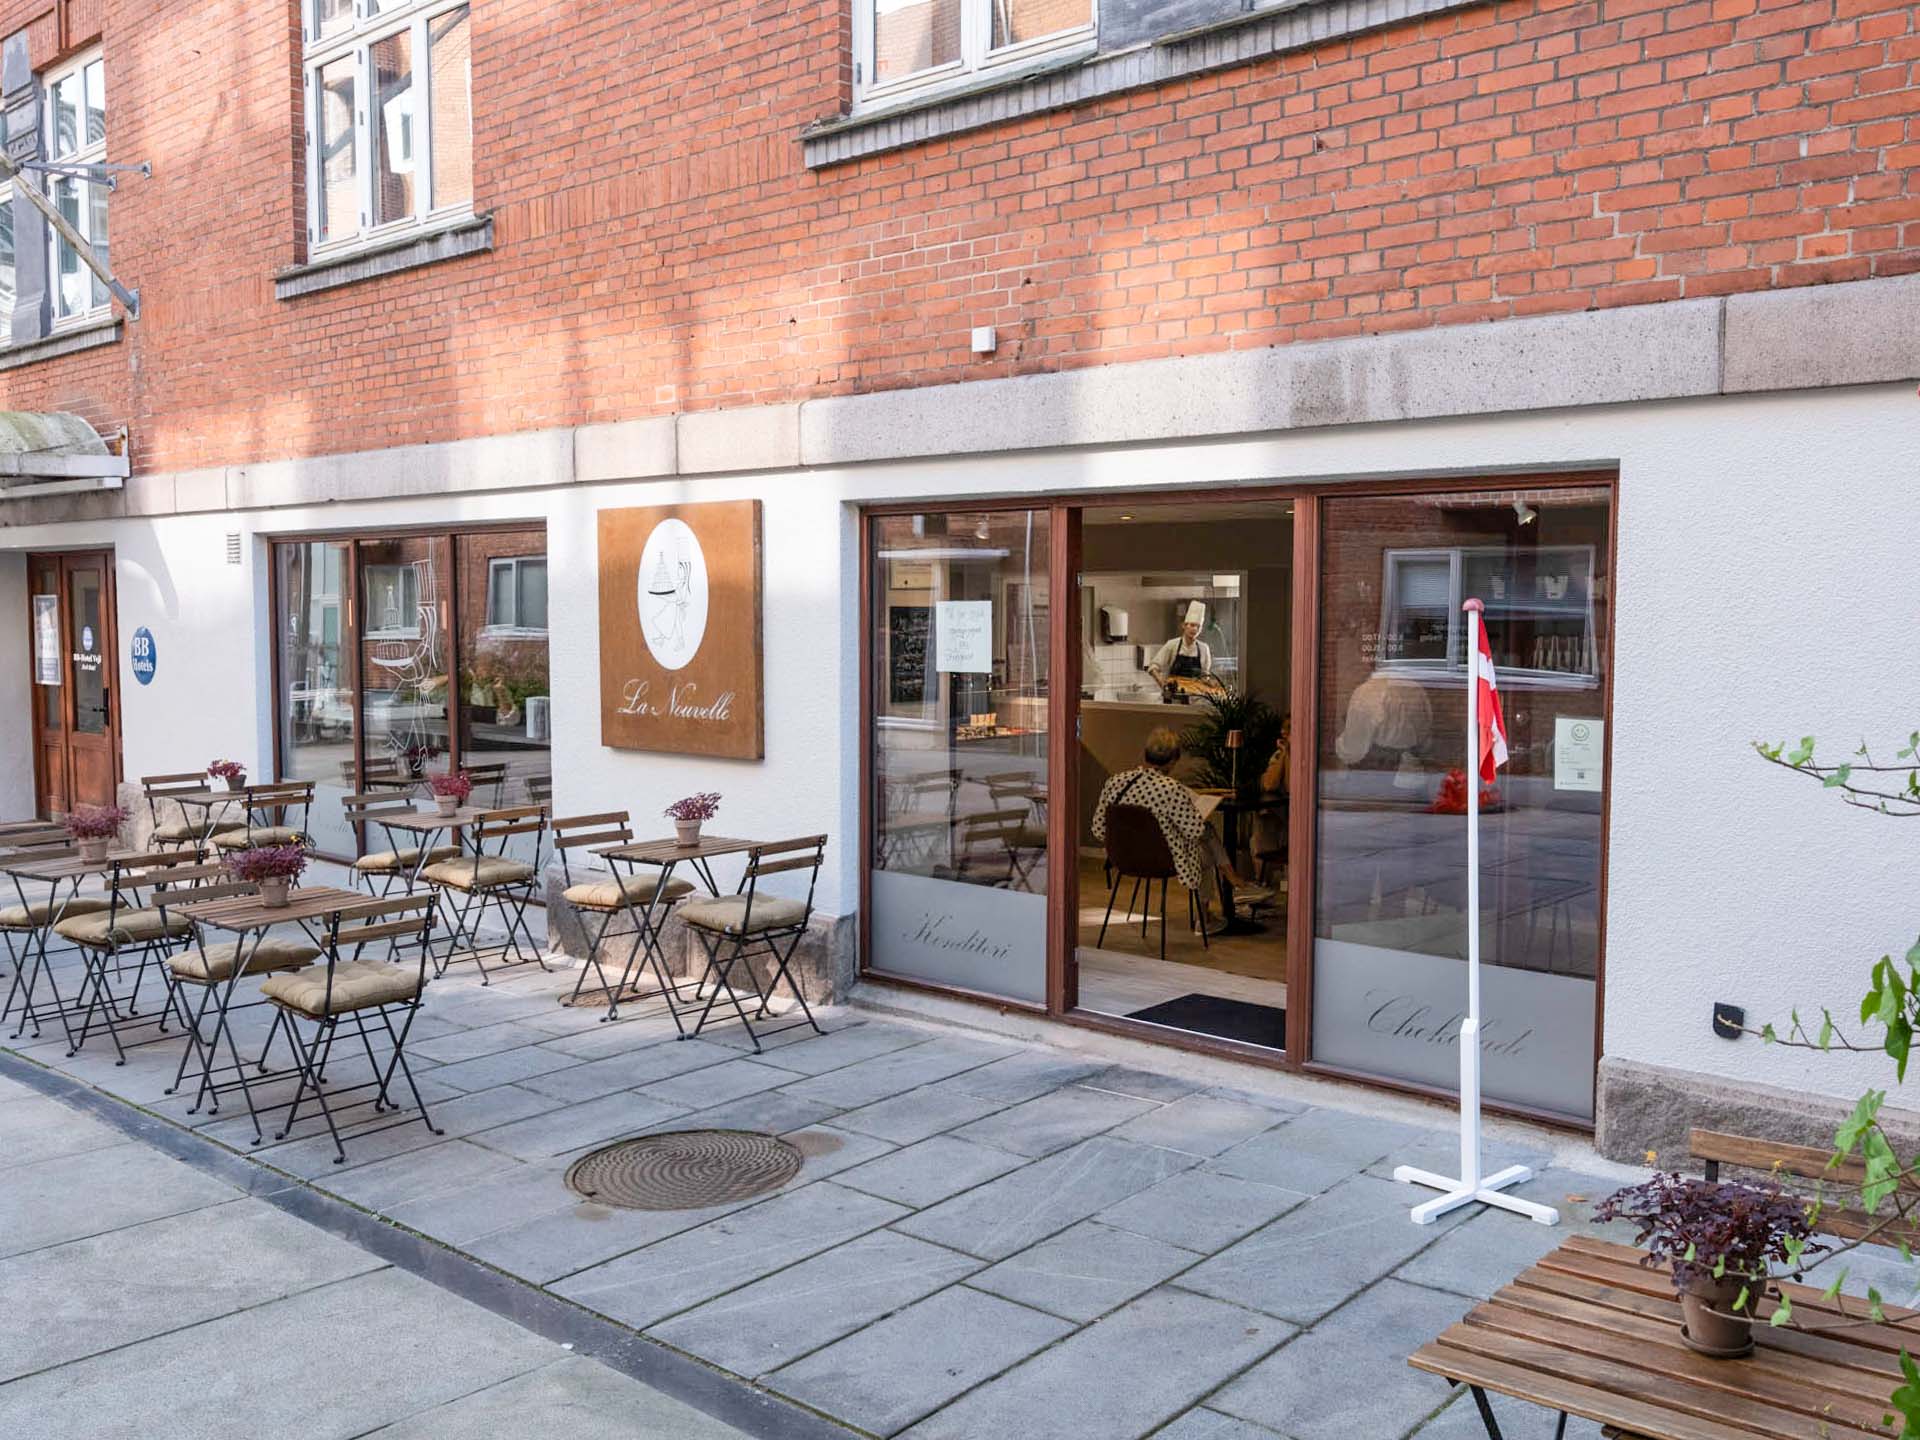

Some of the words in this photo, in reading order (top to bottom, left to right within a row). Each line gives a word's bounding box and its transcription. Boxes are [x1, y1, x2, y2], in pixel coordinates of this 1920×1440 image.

[133, 637, 150, 657] BB
[616, 678, 648, 715] La
[651, 683, 736, 721] Nouvelle
